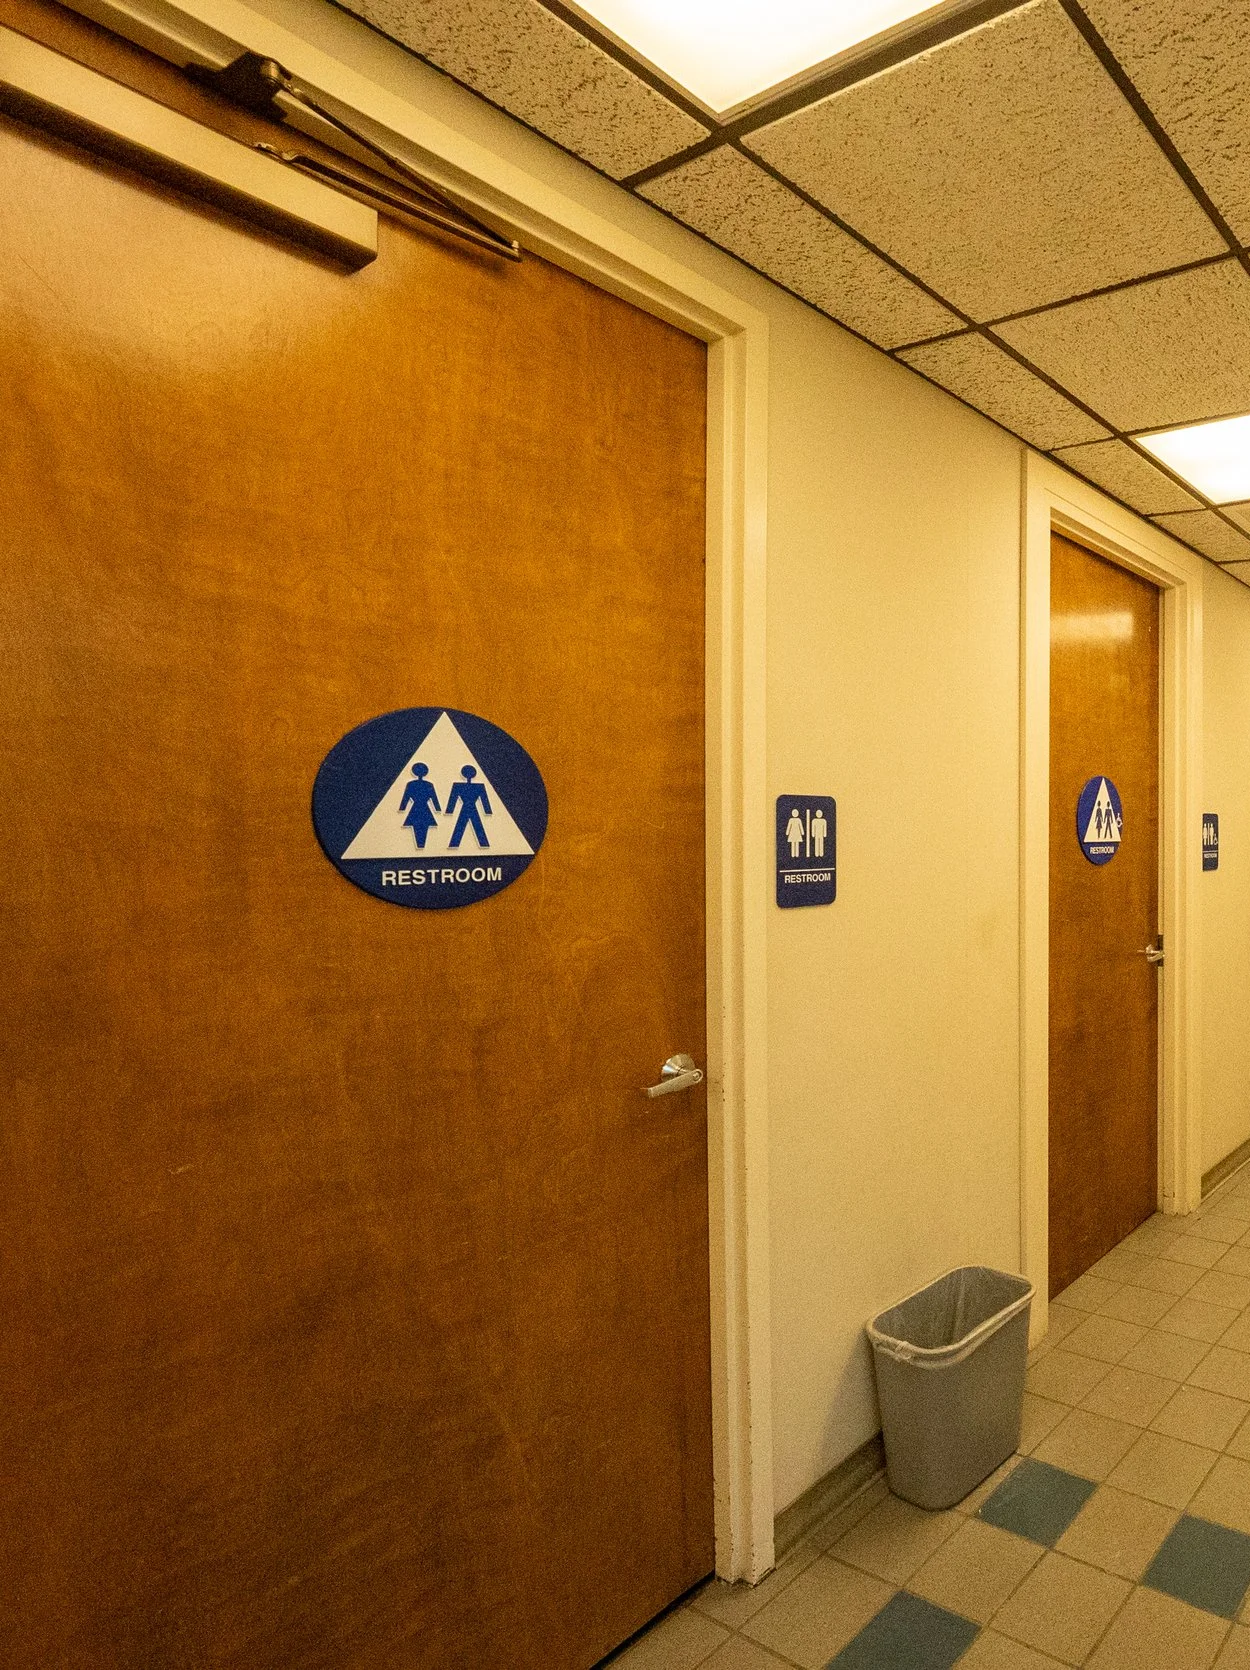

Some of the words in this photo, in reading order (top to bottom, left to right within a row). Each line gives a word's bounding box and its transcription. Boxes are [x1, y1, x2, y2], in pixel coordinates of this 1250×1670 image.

[1090, 846, 1115, 854] RESTROOM
[381, 867, 502, 886] RESTROOM
[784, 873, 831, 884] RESTROOM
